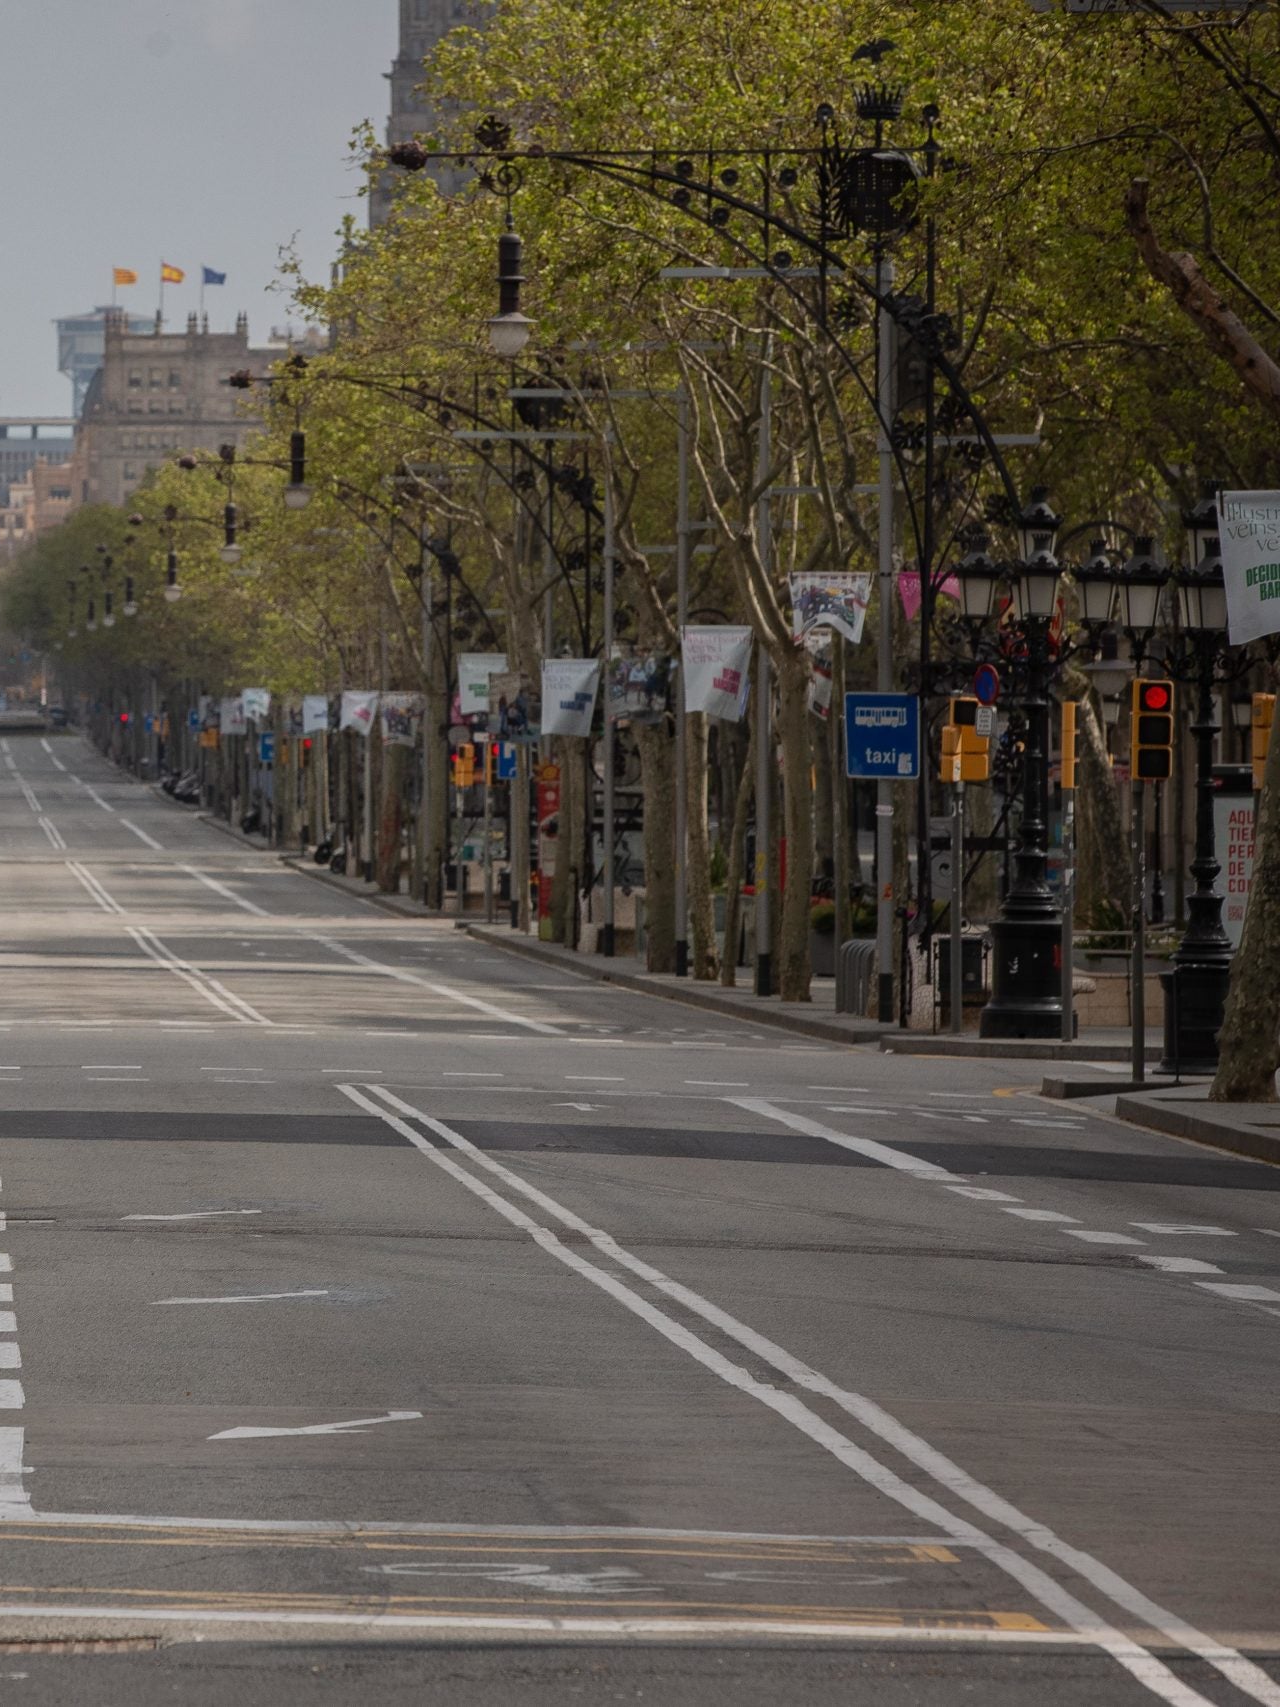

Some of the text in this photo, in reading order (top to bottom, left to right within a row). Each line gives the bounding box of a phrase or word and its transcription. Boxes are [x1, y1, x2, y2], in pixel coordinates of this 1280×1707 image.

[865, 747, 896, 764] taxi
[1228, 862, 1245, 876] DE
[1228, 879, 1251, 893] CO
